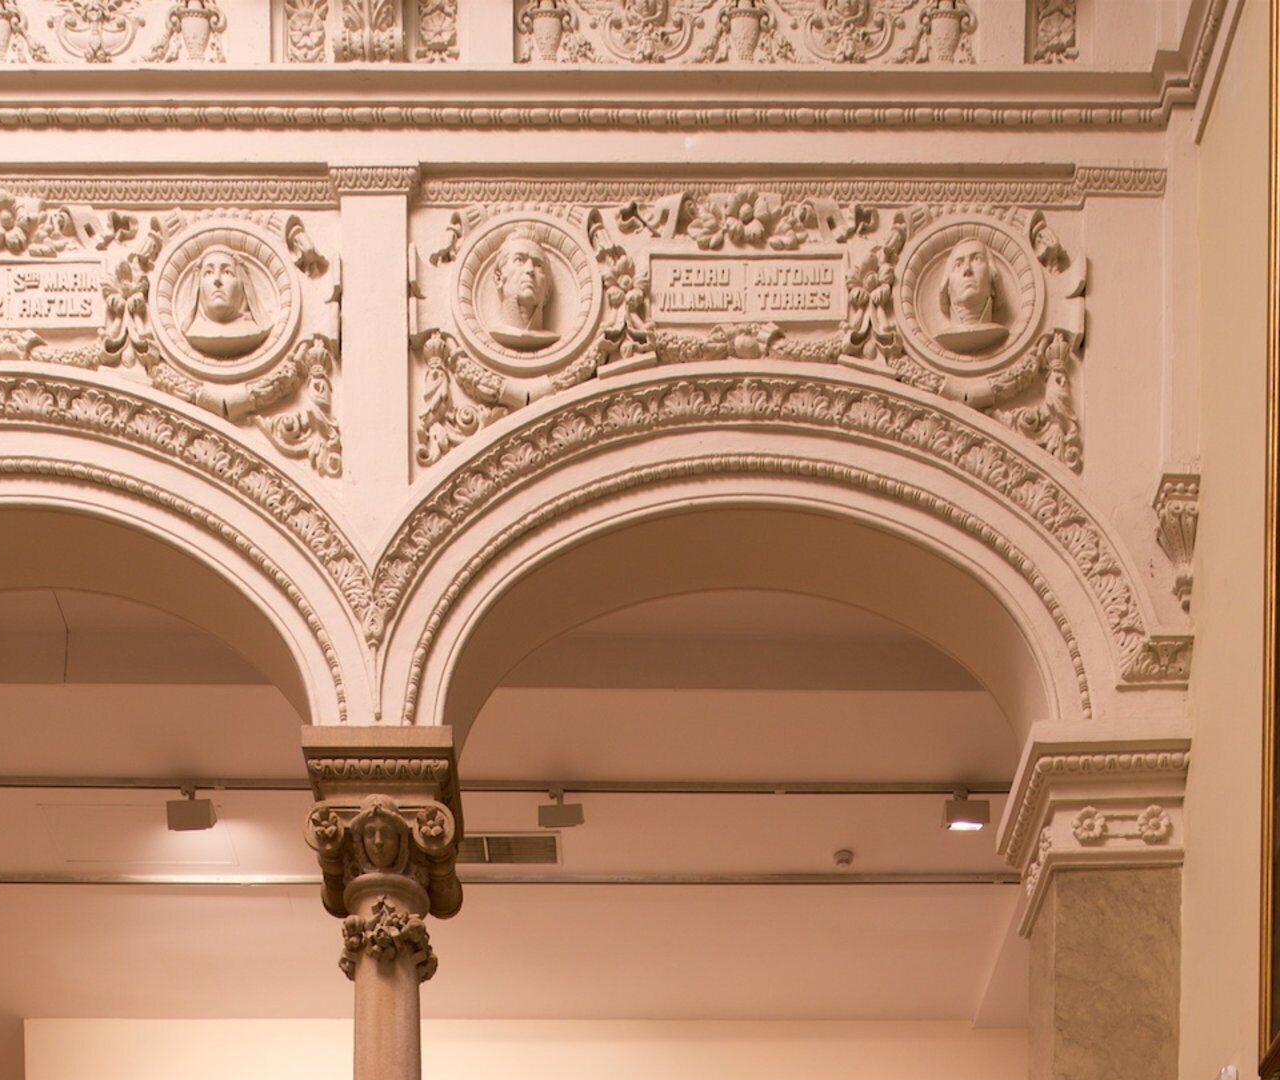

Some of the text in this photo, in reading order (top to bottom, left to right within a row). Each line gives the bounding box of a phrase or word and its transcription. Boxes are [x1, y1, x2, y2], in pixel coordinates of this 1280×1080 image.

[44, 272, 98, 292] MARIA
[669, 268, 731, 287] PEDRO
[754, 267, 834, 286] ANTONIO
[659, 292, 743, 312] VILLACAMPA
[757, 292, 831, 311] TORRES
